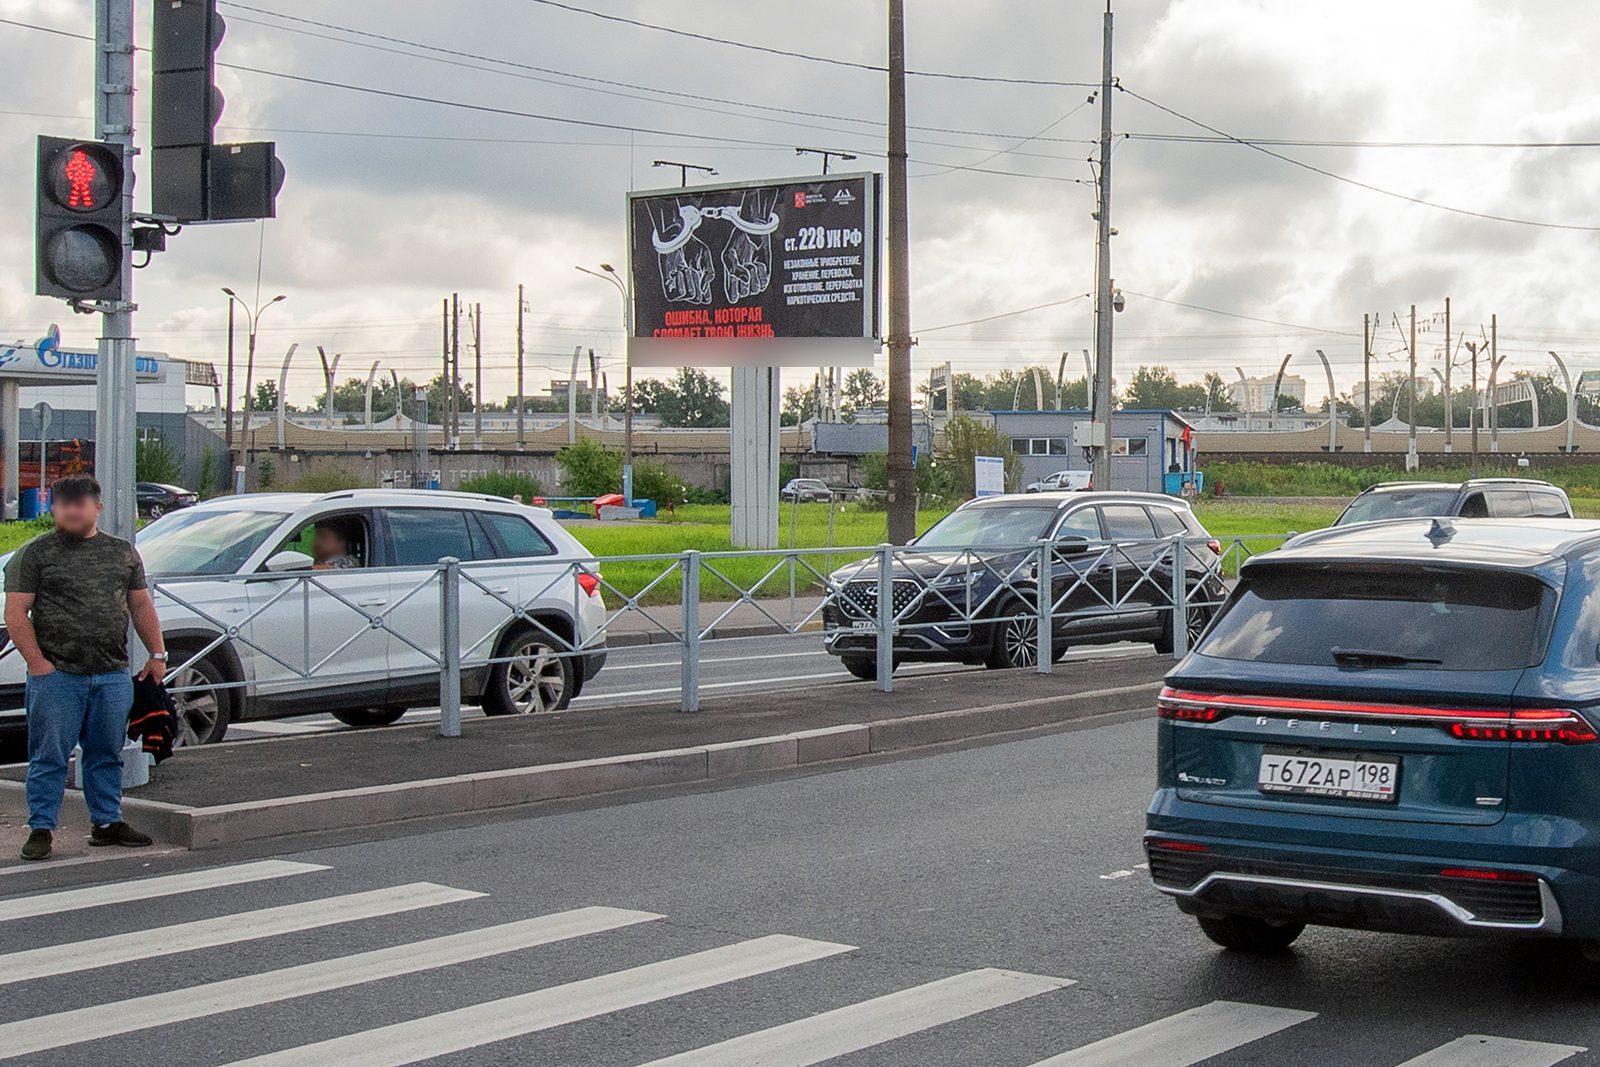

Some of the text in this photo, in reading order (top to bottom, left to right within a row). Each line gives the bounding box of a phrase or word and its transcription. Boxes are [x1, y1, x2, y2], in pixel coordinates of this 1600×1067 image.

[798, 226, 825, 251] 228
[826, 229, 841, 249] УК
[842, 227, 863, 248] РФ
[664, 306, 763, 327] ОШИБКА, КОТОРАЯ
[736, 323, 775, 338] ЖИЗНЬ
[1255, 715, 1402, 736] GEELY
[1267, 759, 1390, 787] Т672АР 198
